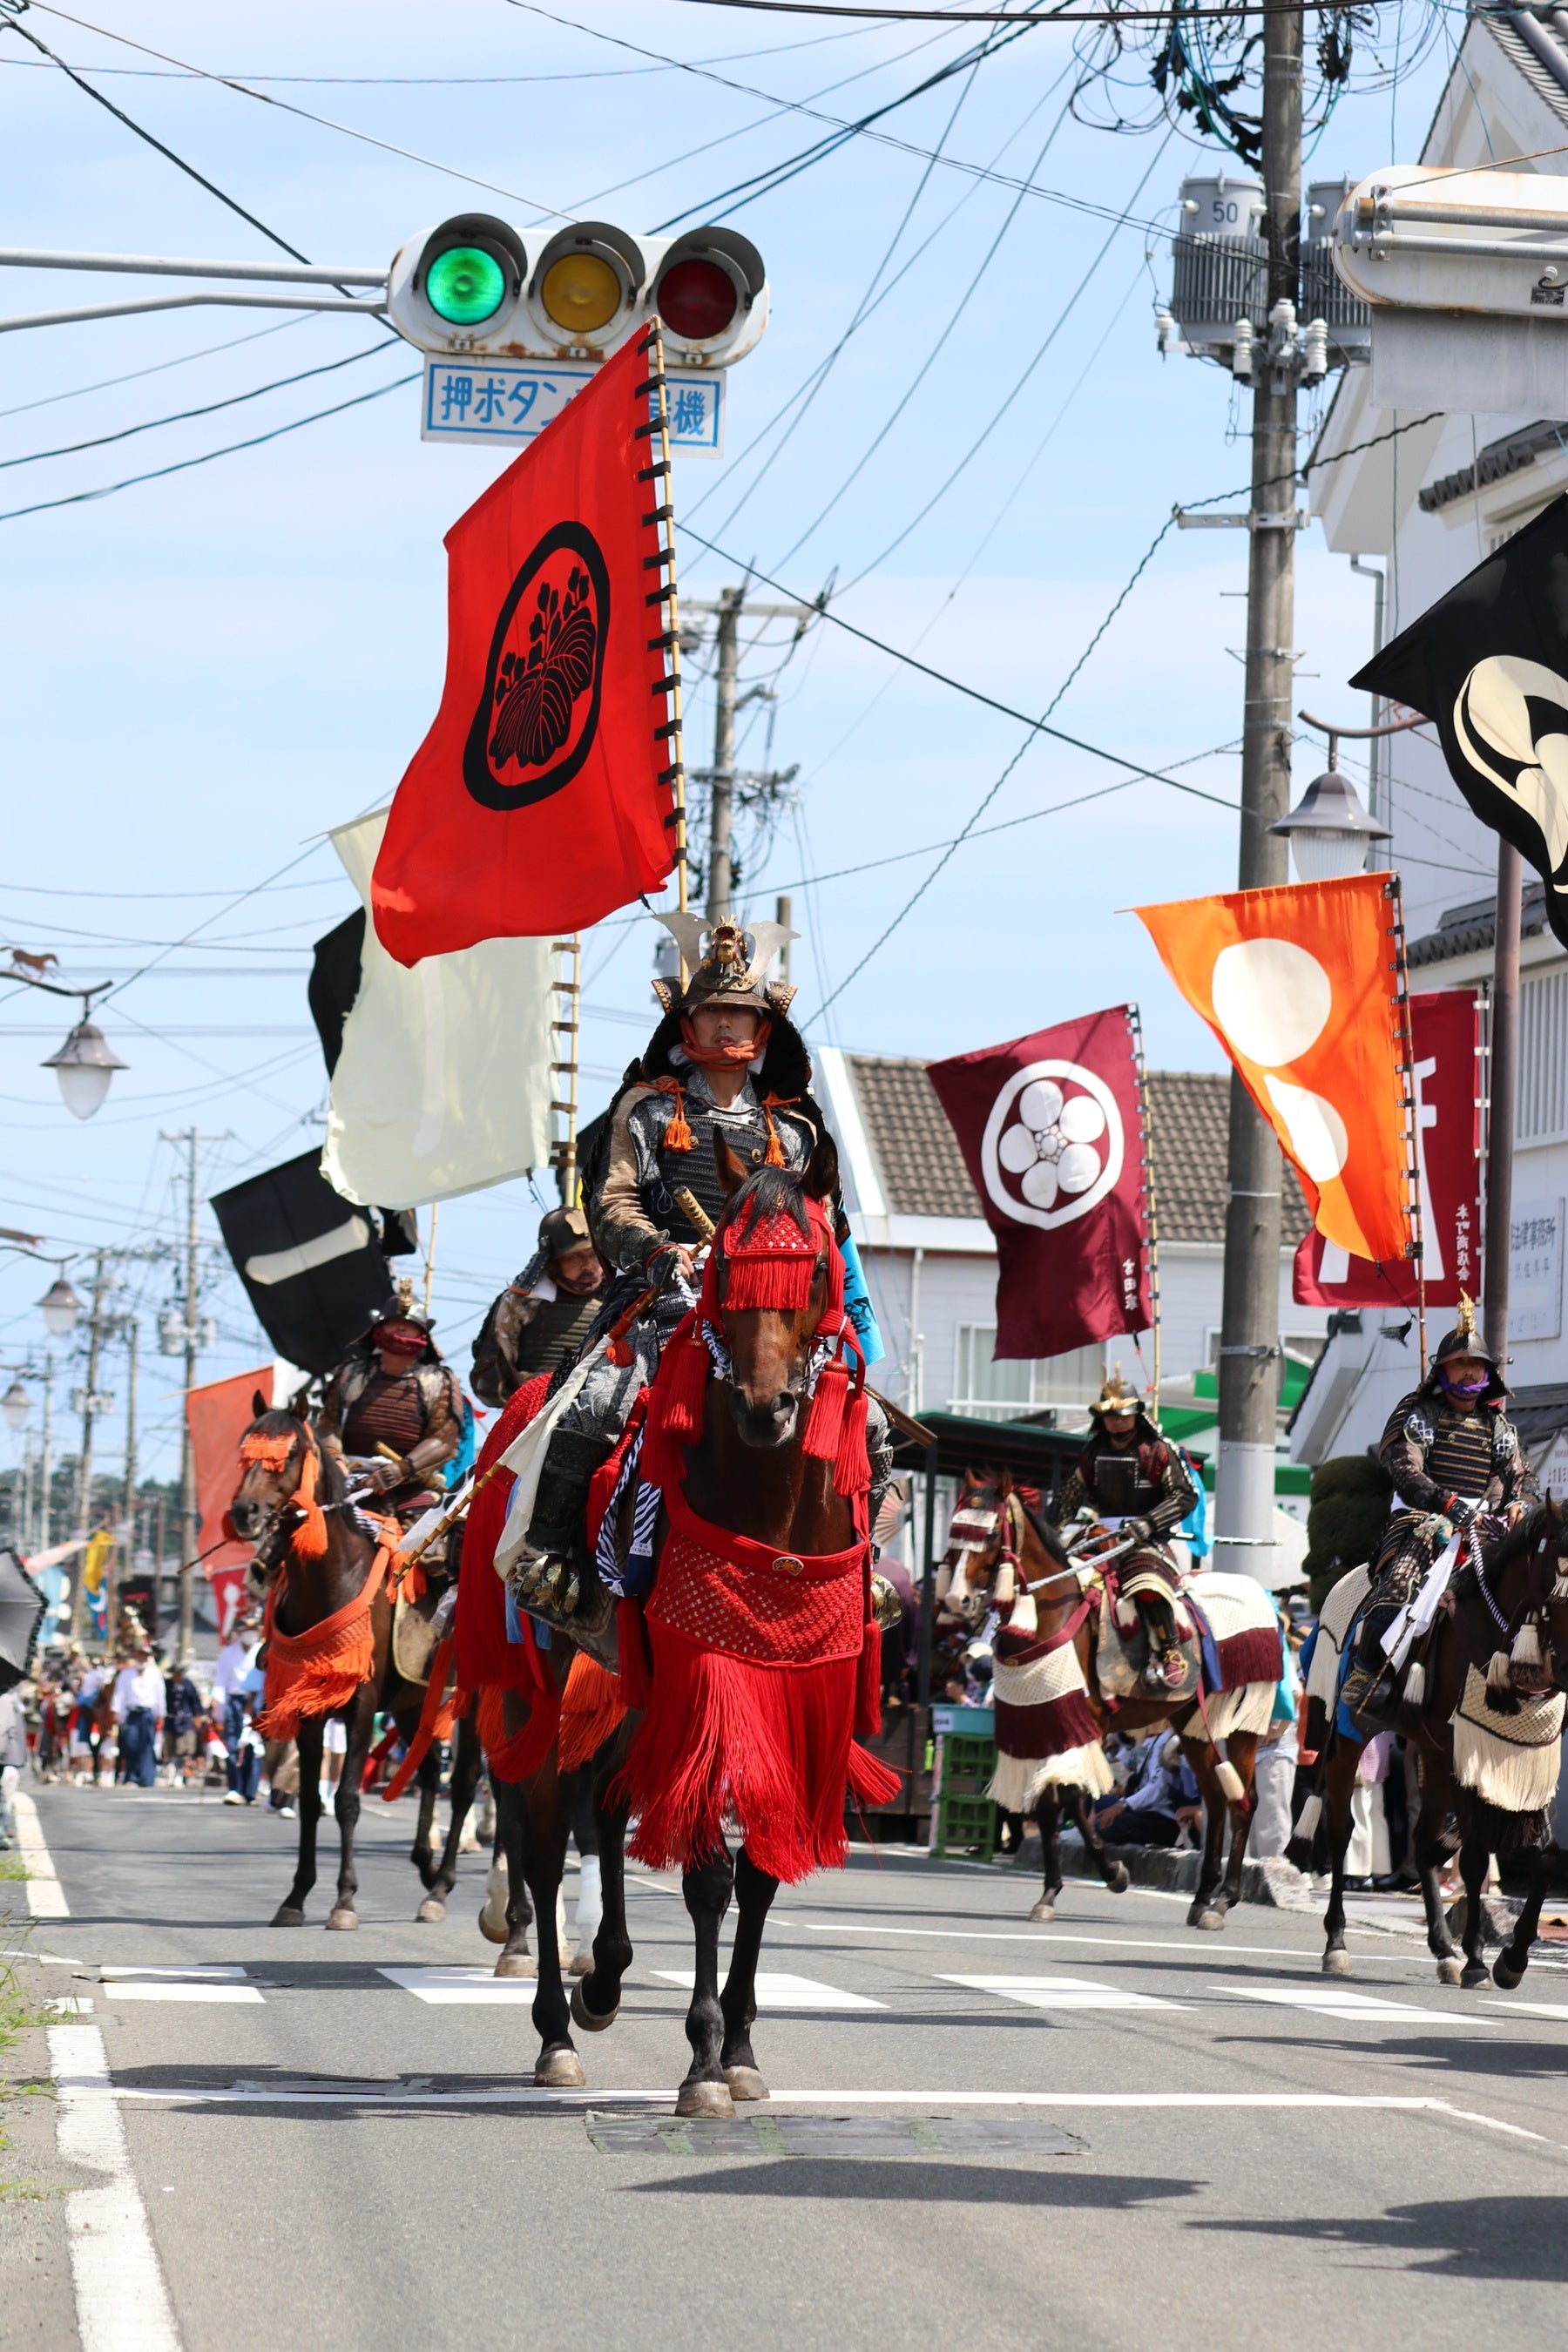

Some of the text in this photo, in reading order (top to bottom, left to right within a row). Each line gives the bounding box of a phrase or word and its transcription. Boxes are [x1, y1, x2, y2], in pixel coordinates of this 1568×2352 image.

[1213, 201, 1238, 223] 50
[441, 375, 706, 436] 押ボタン号機
